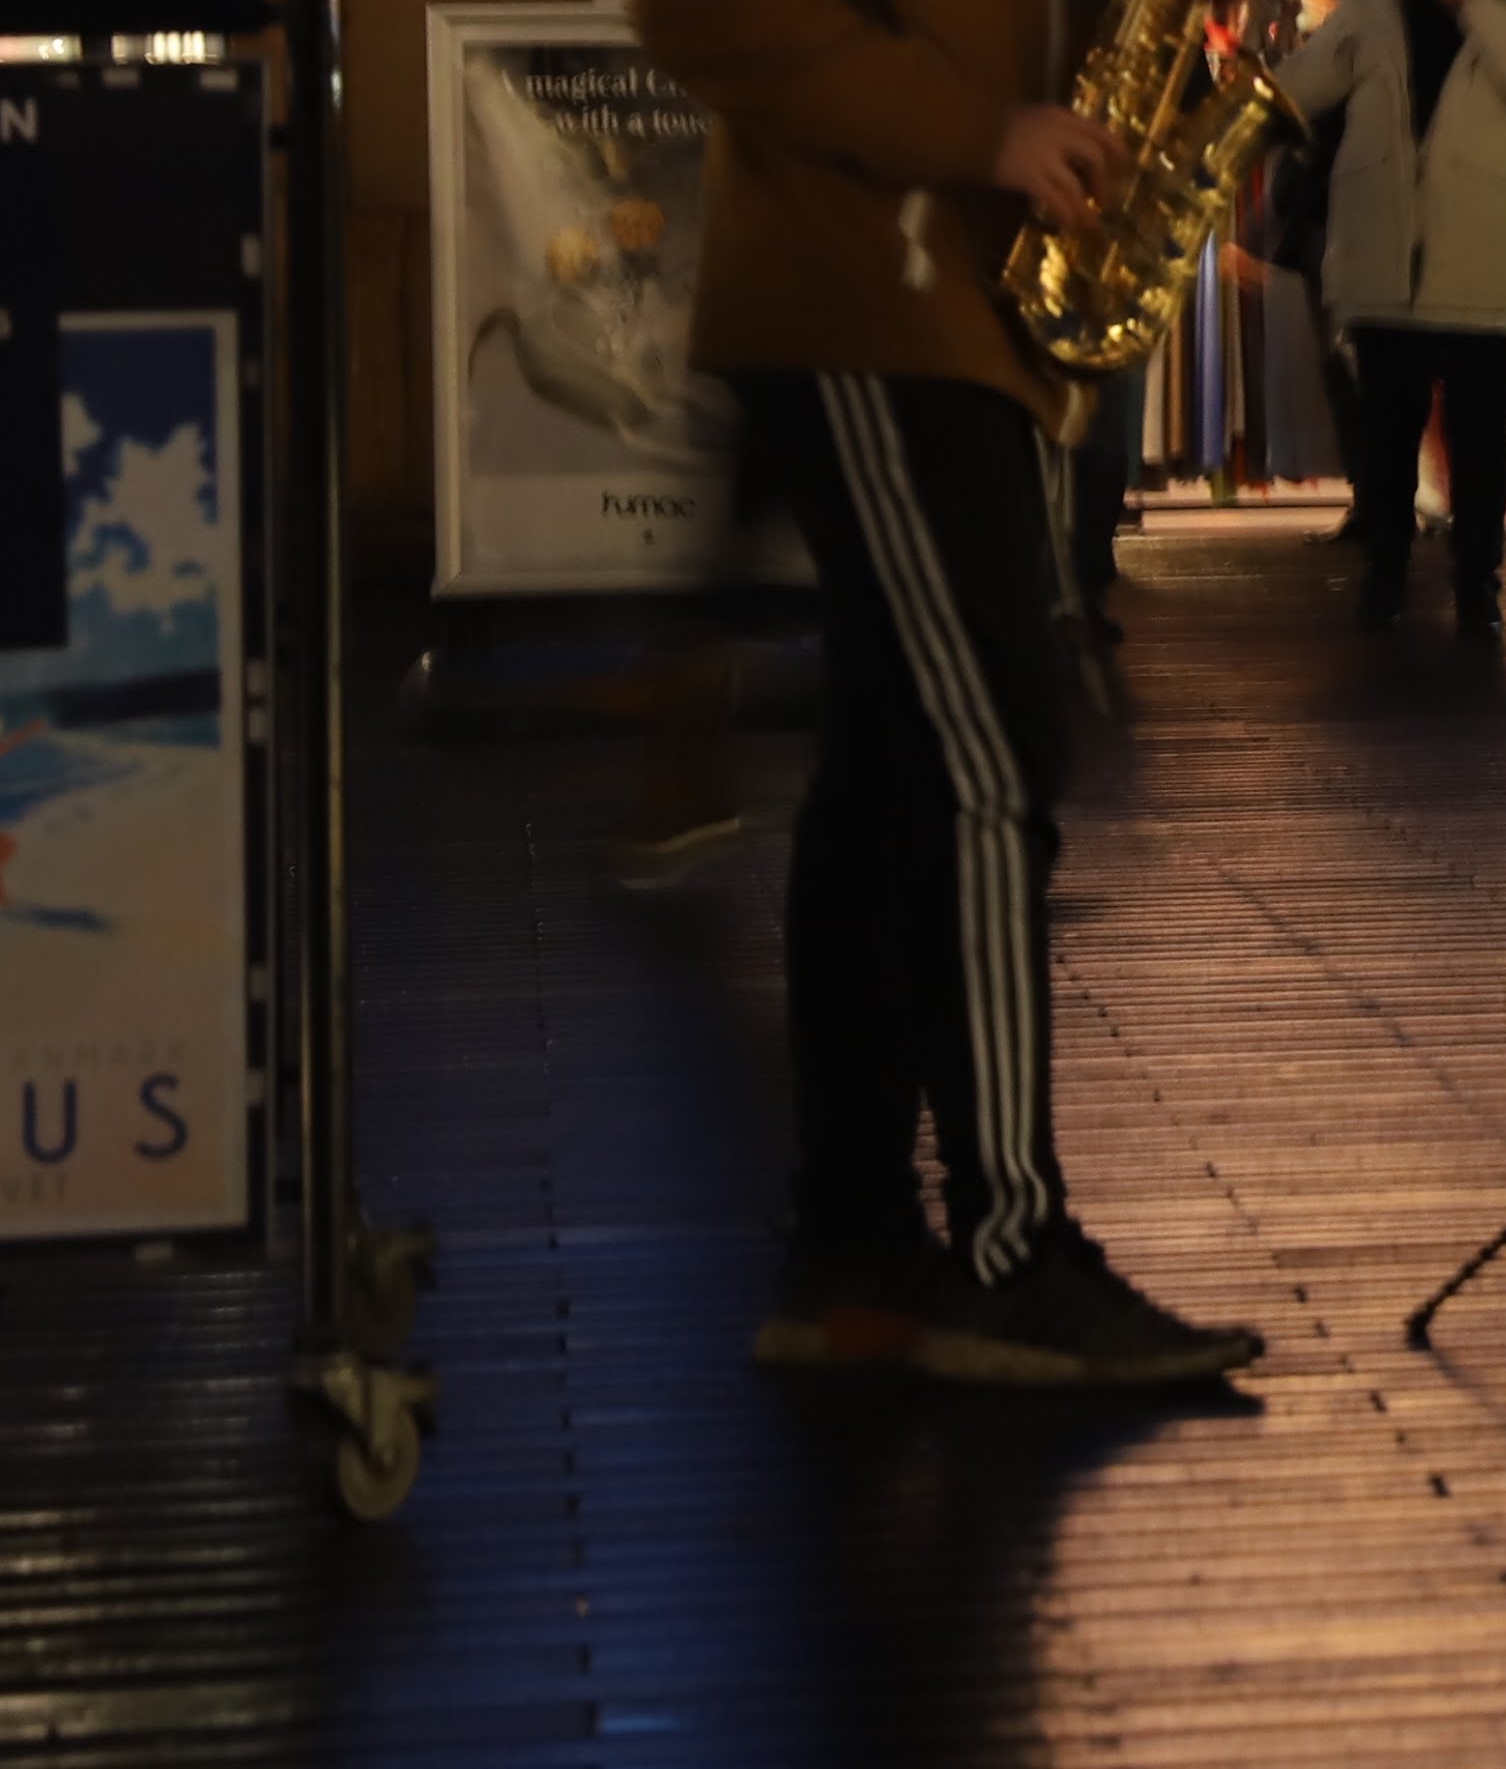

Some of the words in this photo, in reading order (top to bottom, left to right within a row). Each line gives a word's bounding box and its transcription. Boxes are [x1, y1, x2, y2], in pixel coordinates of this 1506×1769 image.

[526, 67, 638, 104] magical
[556, 105, 619, 138] with
[627, 112, 646, 140] a
[22, 1074, 188, 1166] US
